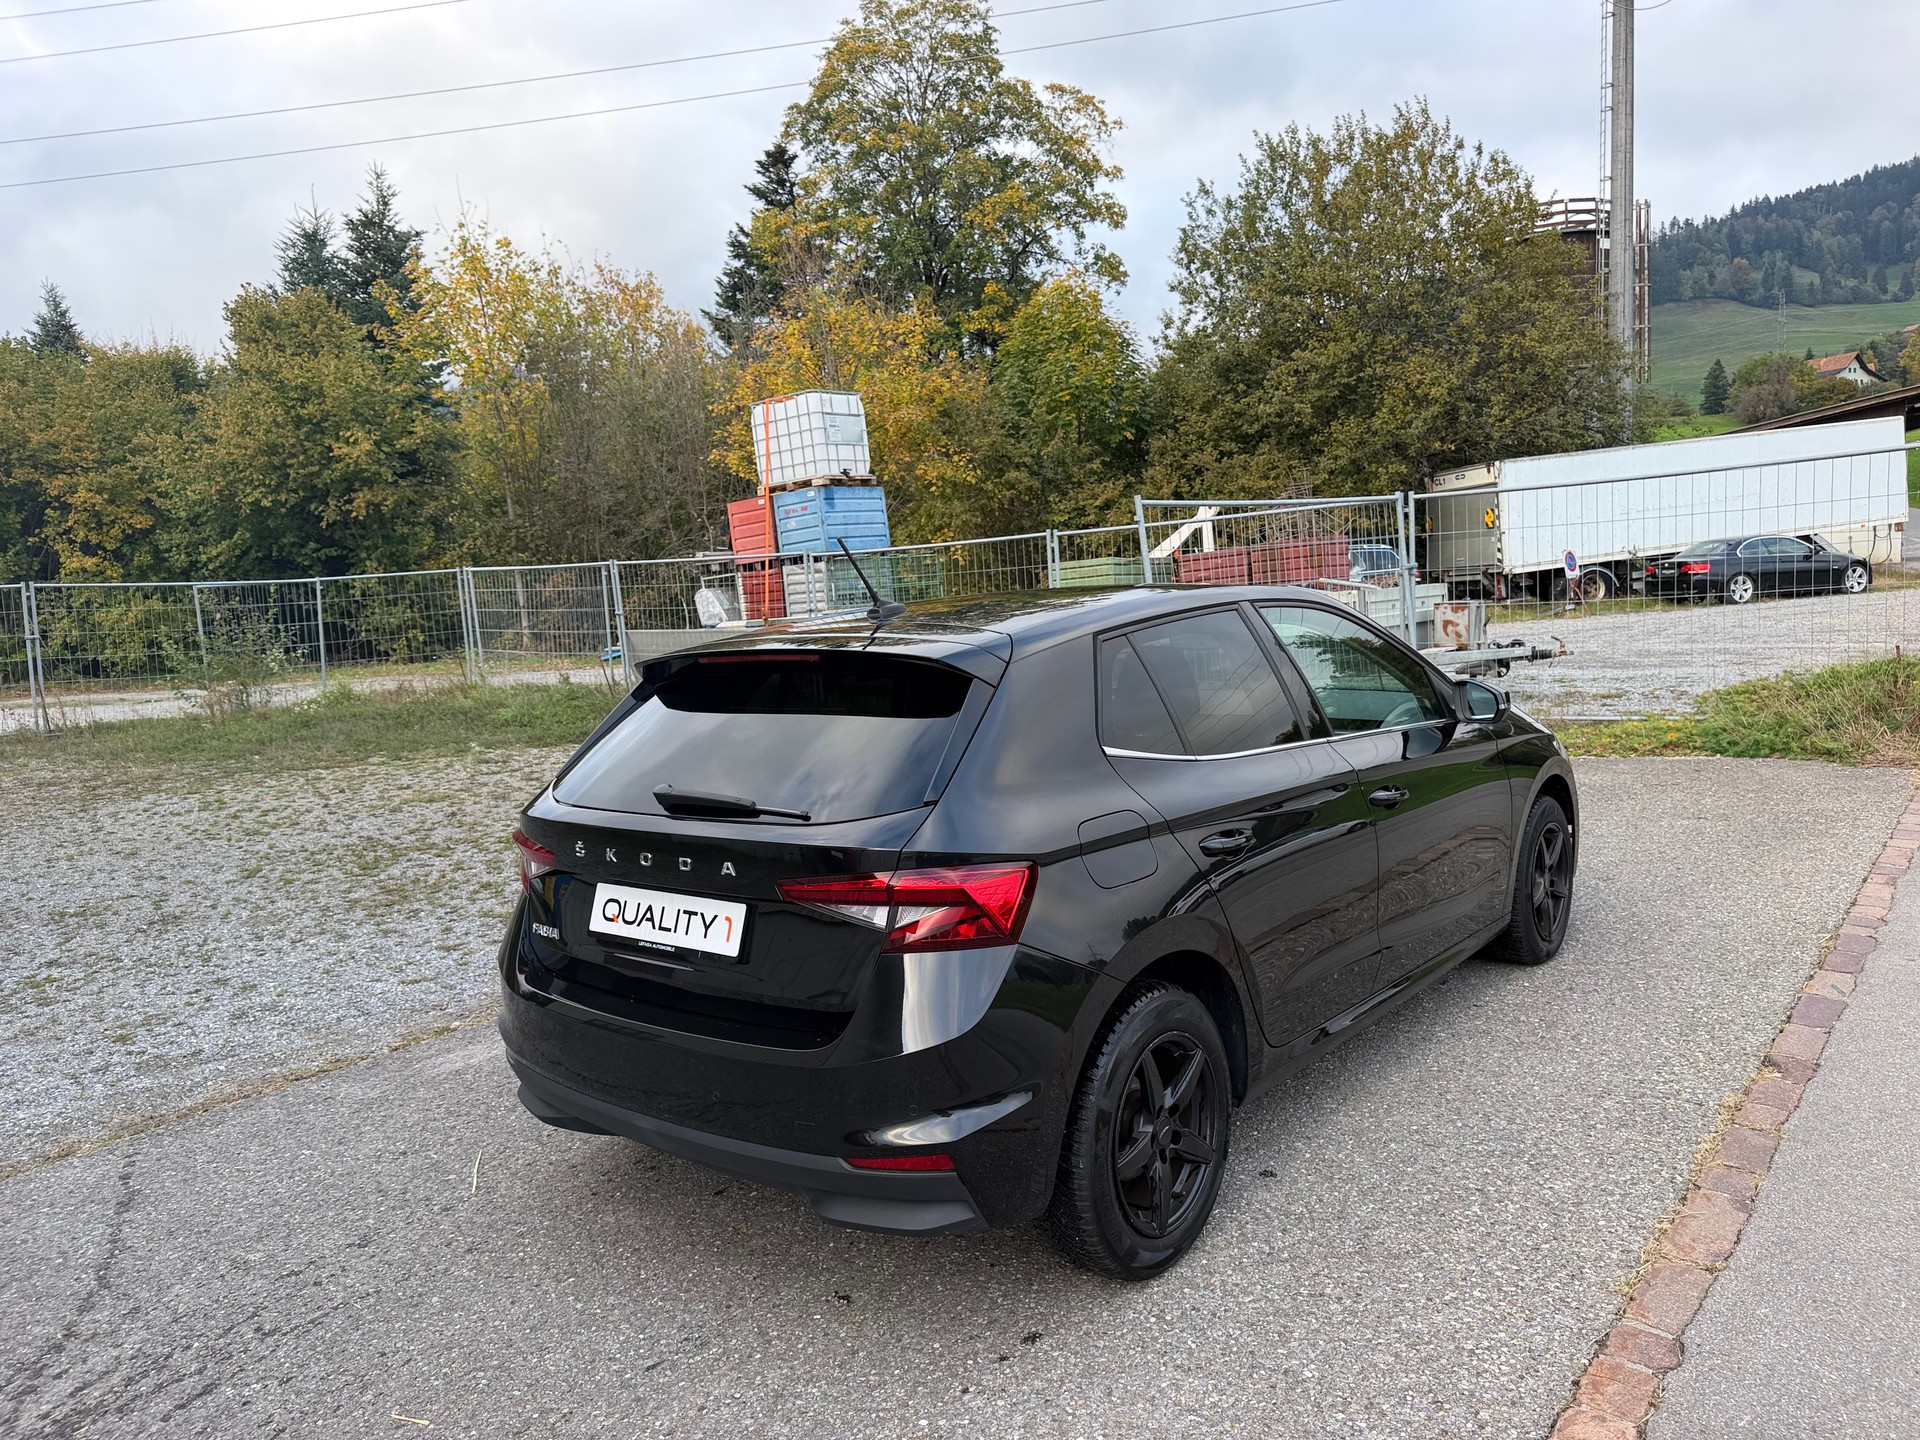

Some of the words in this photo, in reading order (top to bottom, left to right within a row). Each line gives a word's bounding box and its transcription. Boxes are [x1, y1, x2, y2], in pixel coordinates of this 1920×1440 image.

[575, 840, 736, 877] ŠKODA
[532, 922, 560, 940] FABIA
[602, 898, 719, 939] QUALITY
[724, 915, 733, 943] 1
